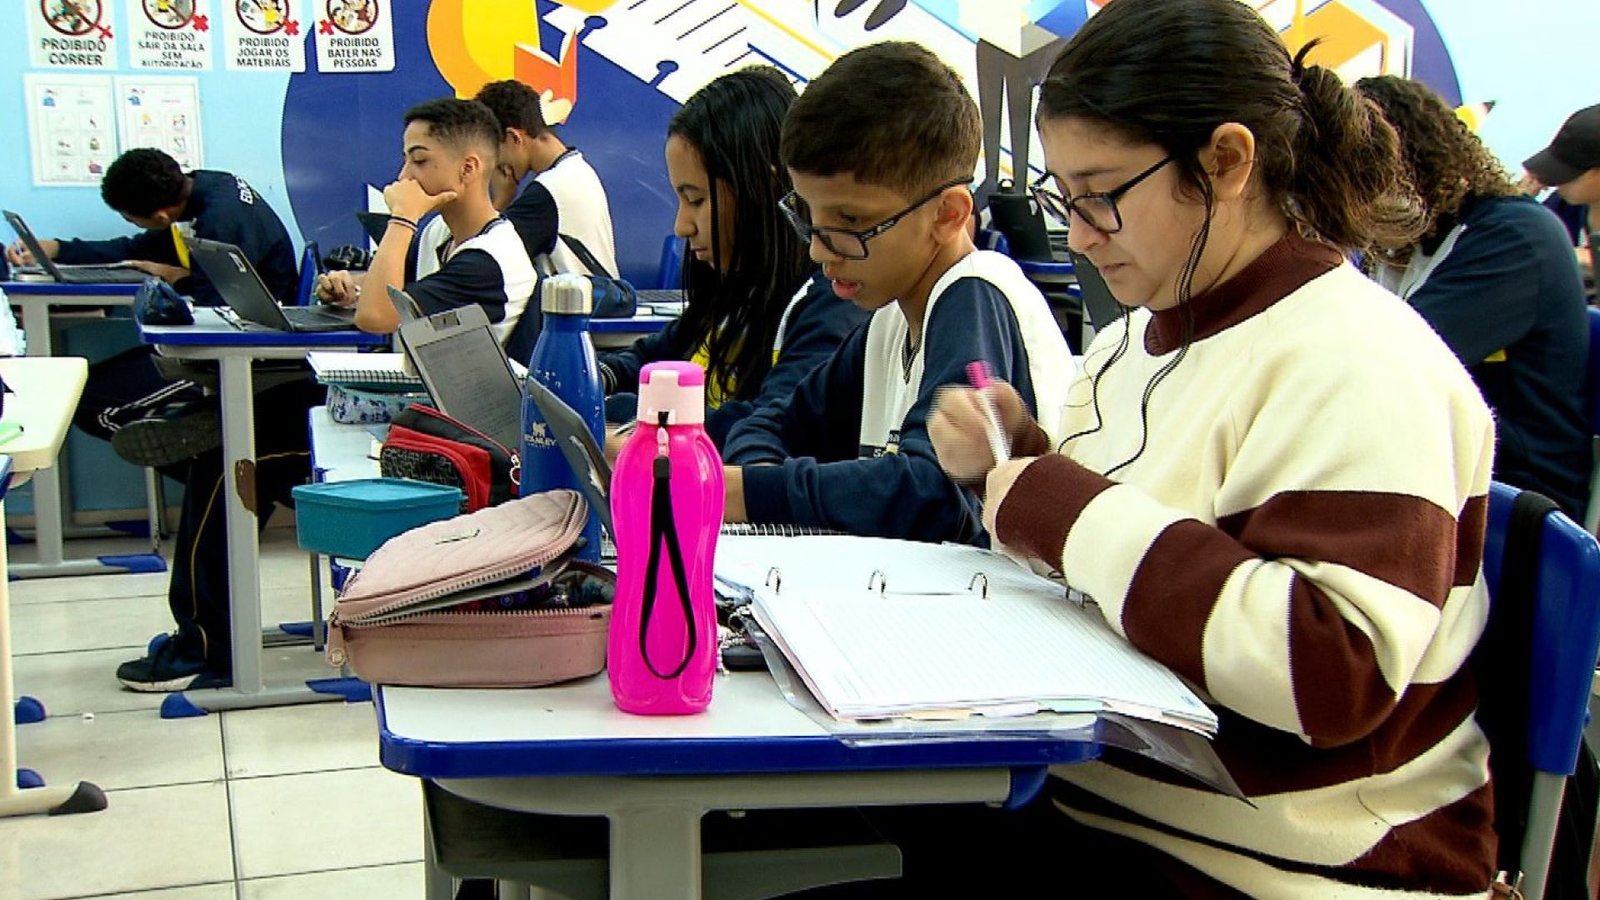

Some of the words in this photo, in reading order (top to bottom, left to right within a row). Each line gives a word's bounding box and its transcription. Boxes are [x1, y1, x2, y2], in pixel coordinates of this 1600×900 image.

[145, 31, 195, 42] PROIBIDO
[239, 37, 289, 47] PROIBIDO
[329, 37, 379, 47] PROIBIDO
[41, 37, 107, 52] PROIBIDO
[138, 41, 161, 50] SAIR
[163, 42, 177, 51] DA
[181, 43, 205, 52] SALA
[161, 51, 182, 60] SEM
[238, 47, 272, 58] JOGAR
[275, 47, 289, 58] OS
[327, 47, 359, 58] BATER
[361, 47, 382, 57] NAS
[49, 52, 103, 66] CORRER
[236, 57, 291, 68] MATERIAIS
[333, 58, 378, 68] PESSOAS
